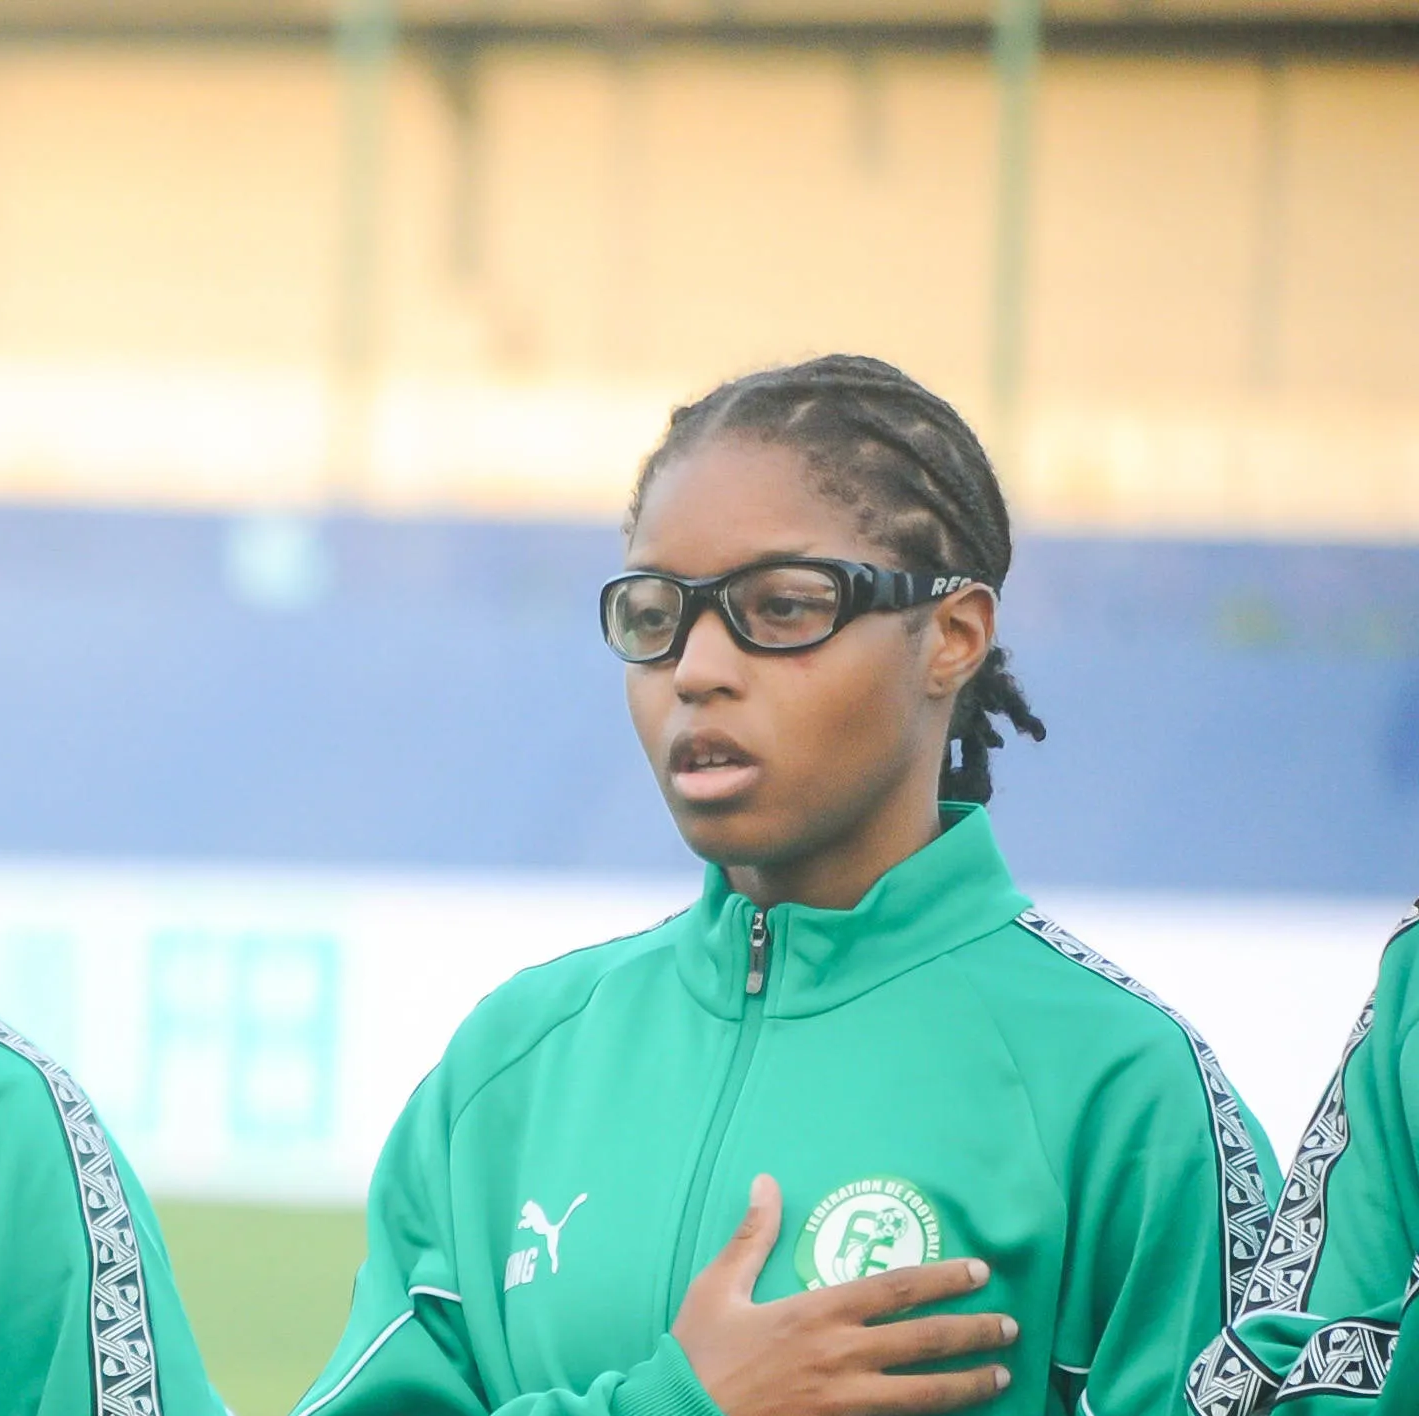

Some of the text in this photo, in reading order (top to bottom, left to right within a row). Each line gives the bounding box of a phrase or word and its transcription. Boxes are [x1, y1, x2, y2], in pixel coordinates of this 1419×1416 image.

[805, 1179, 940, 1259] FEDERATION DE FOOTBALL
